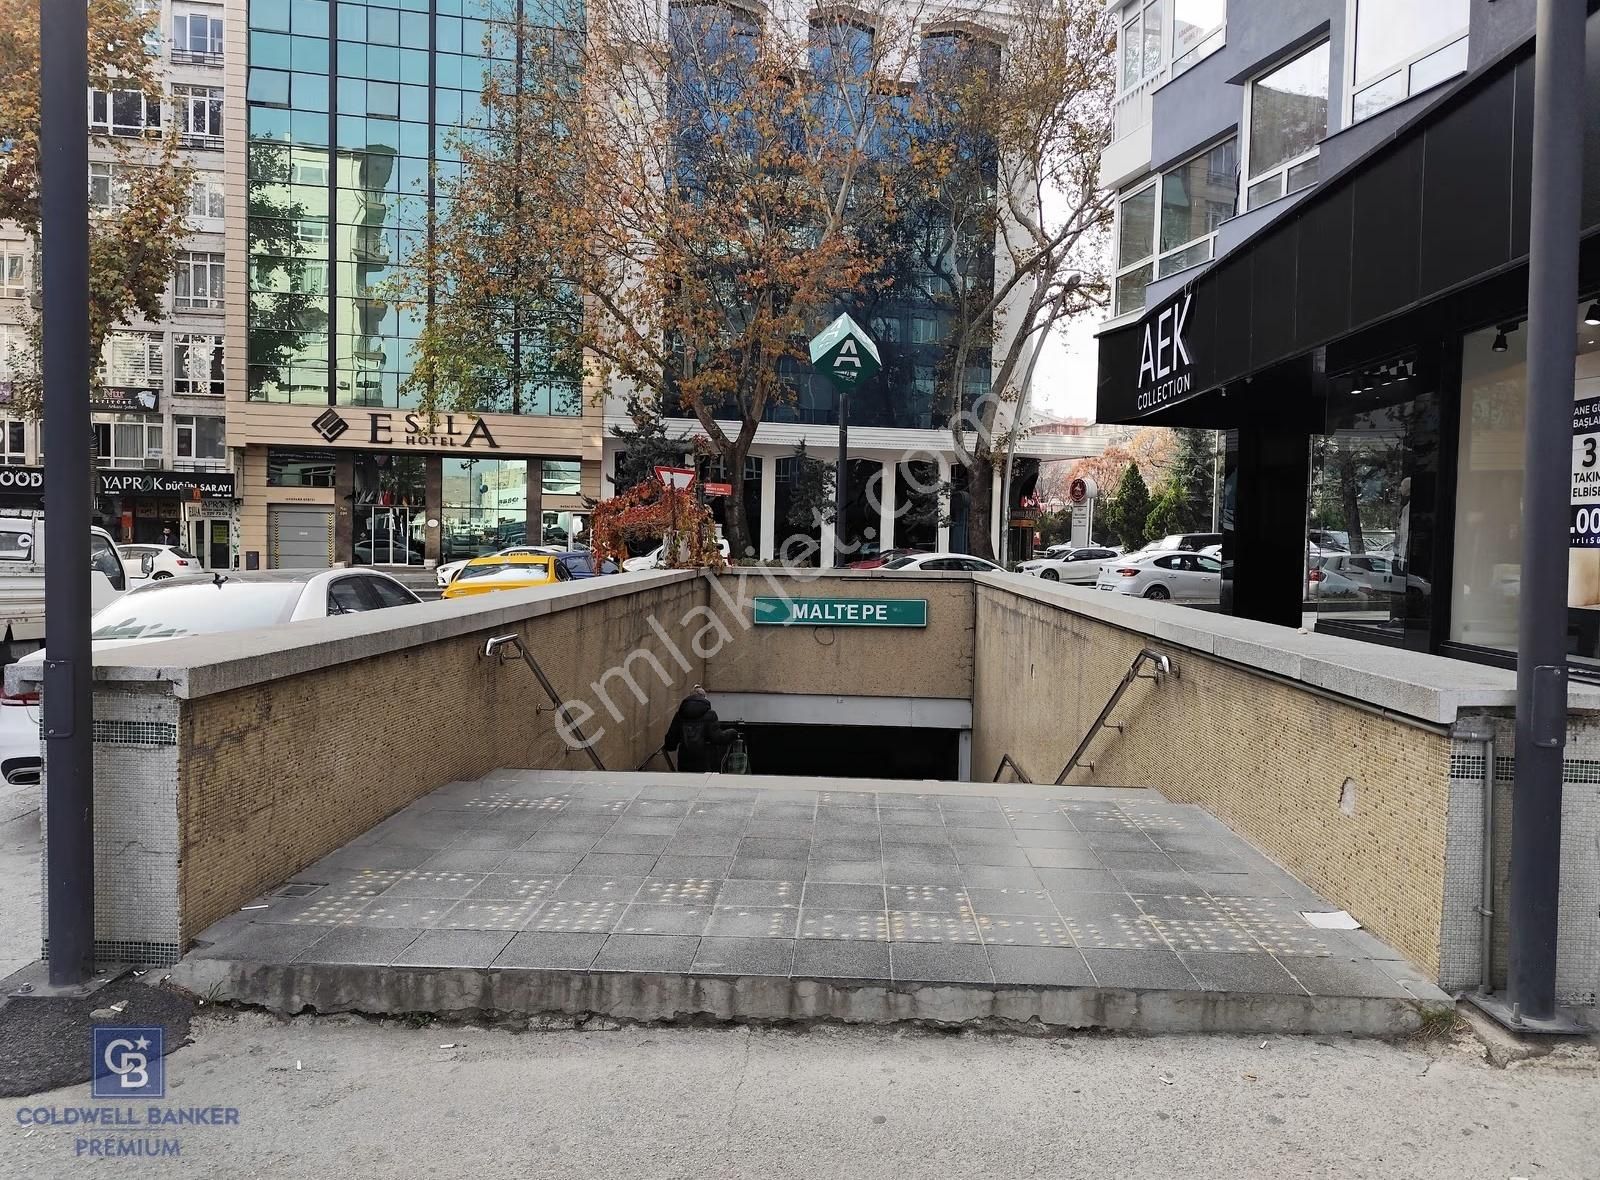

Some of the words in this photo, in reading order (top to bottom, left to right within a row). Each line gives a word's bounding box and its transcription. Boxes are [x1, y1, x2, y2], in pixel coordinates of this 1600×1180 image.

[1138, 293, 1192, 389] AEK
[1137, 372, 1191, 411] COLLECTION
[405, 435, 457, 447] HOTEL
[1582, 437, 1597, 468] 3
[0, 471, 43, 487] OOD
[199, 483, 232, 493] SARAYI
[792, 604, 888, 621] MALTEPE
